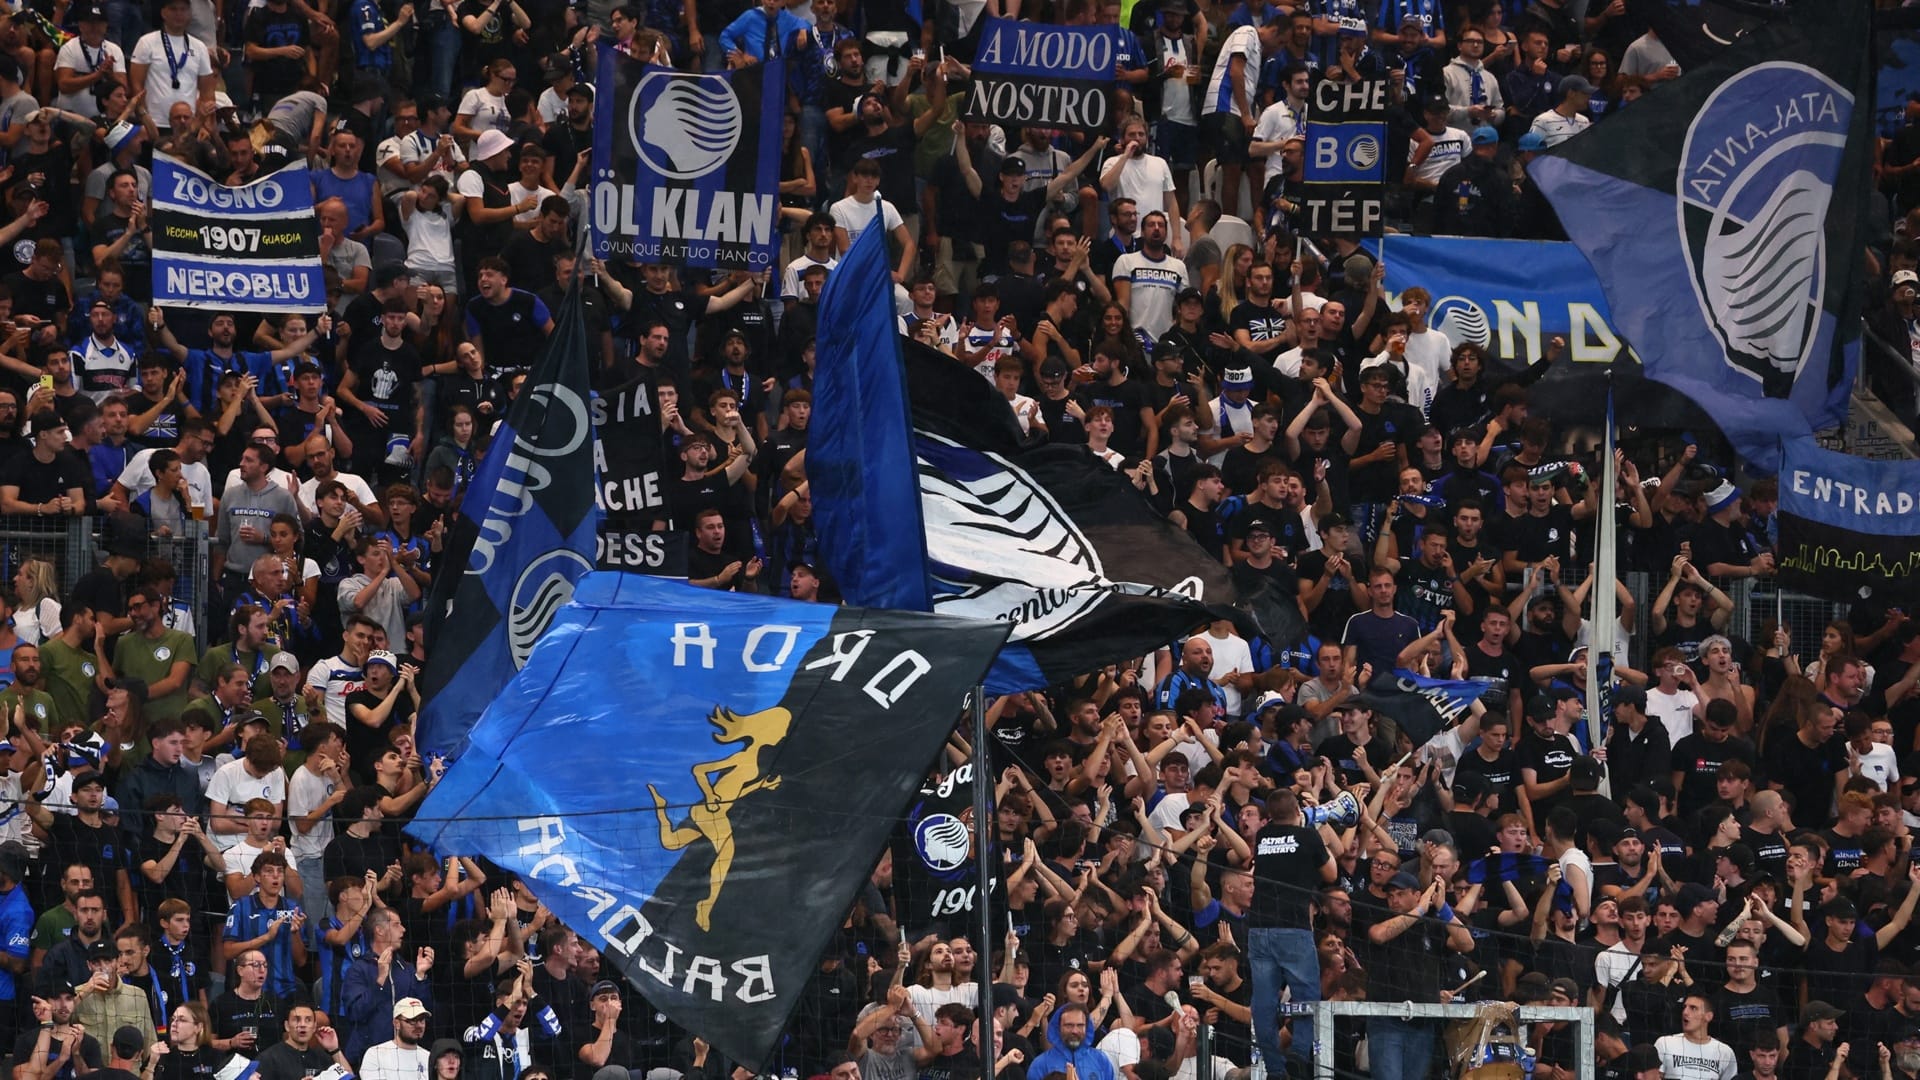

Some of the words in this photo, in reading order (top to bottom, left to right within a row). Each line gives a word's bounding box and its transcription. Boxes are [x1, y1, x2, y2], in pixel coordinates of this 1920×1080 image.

[980, 26, 1004, 63] A
[1010, 29, 1112, 72] MODO
[965, 80, 1108, 128] NOSTRO
[1315, 79, 1385, 112] CHE
[172, 171, 284, 209] ZOGNO
[595, 168, 640, 236] ÖL
[650, 186, 774, 246] KLAN
[1307, 191, 1382, 233] TÉP
[165, 226, 198, 240] VECCHIA
[199, 225, 262, 252] 1907
[262, 231, 302, 246] GUARDIA
[662, 247, 678, 258] AL
[681, 247, 710, 260] TUO
[714, 249, 769, 265] FIANCO
[166, 267, 310, 301] NEROBLU
[1135, 269, 1178, 284] BERGAMO
[1568, 301, 1642, 365] D
[1793, 470, 1920, 516] ENTRAD
[338, 681, 367, 696] Let
[1261, 836, 1286, 845] OLTRE
[1672, 1054, 1720, 1072] WALDSTADION
